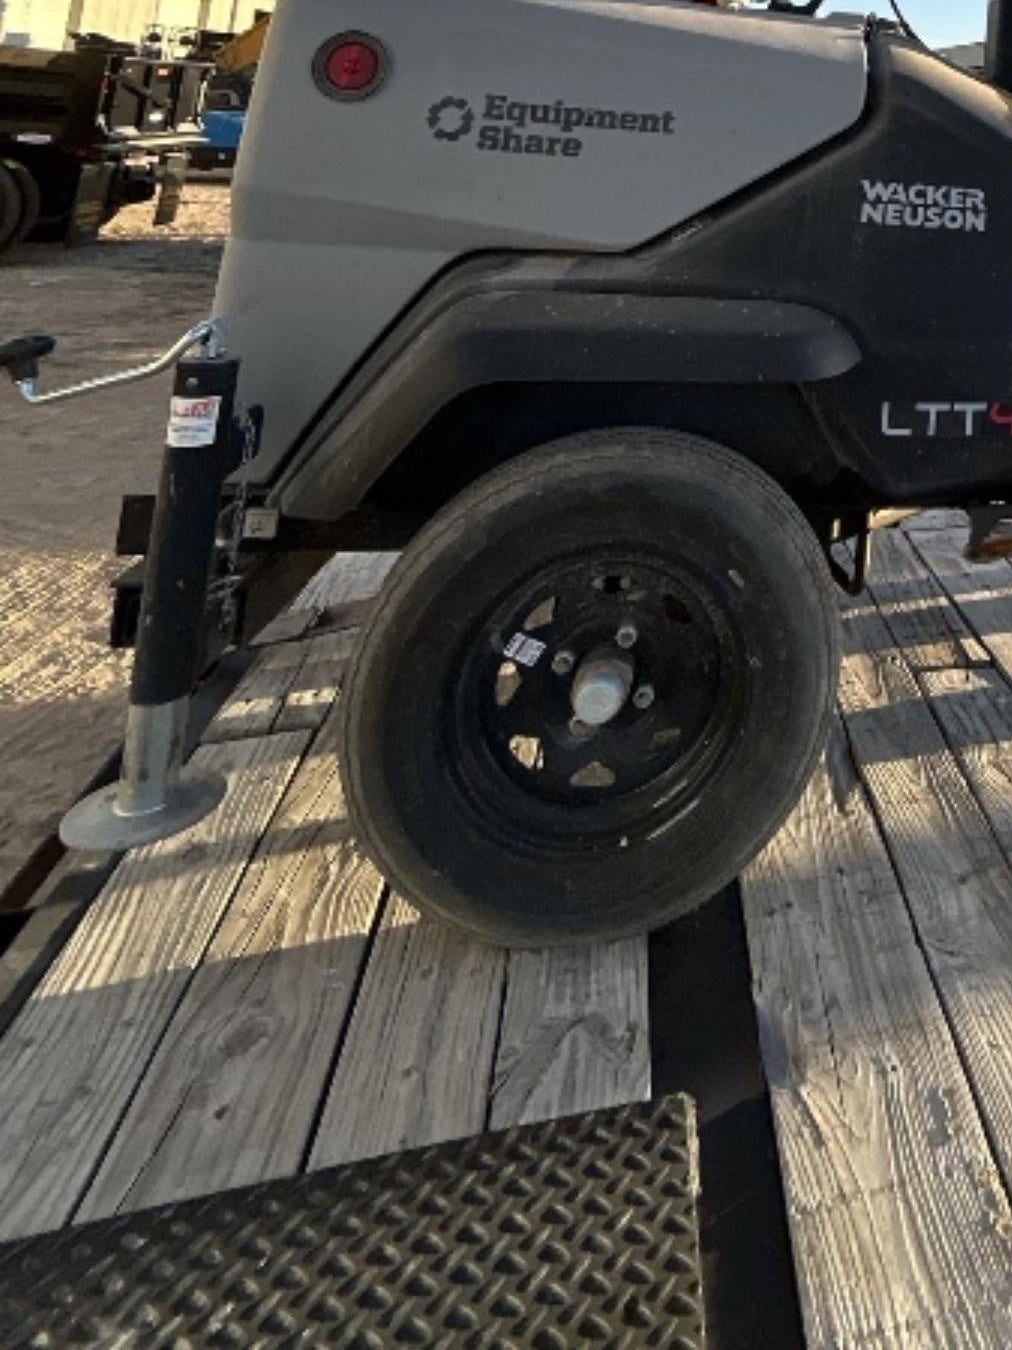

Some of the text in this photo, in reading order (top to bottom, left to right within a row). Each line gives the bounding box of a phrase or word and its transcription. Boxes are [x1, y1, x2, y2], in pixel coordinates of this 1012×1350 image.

[482, 93, 677, 134] Equipment
[476, 125, 583, 157] Share
[860, 179, 987, 211] WACKER
[860, 201, 987, 232] NEUSON
